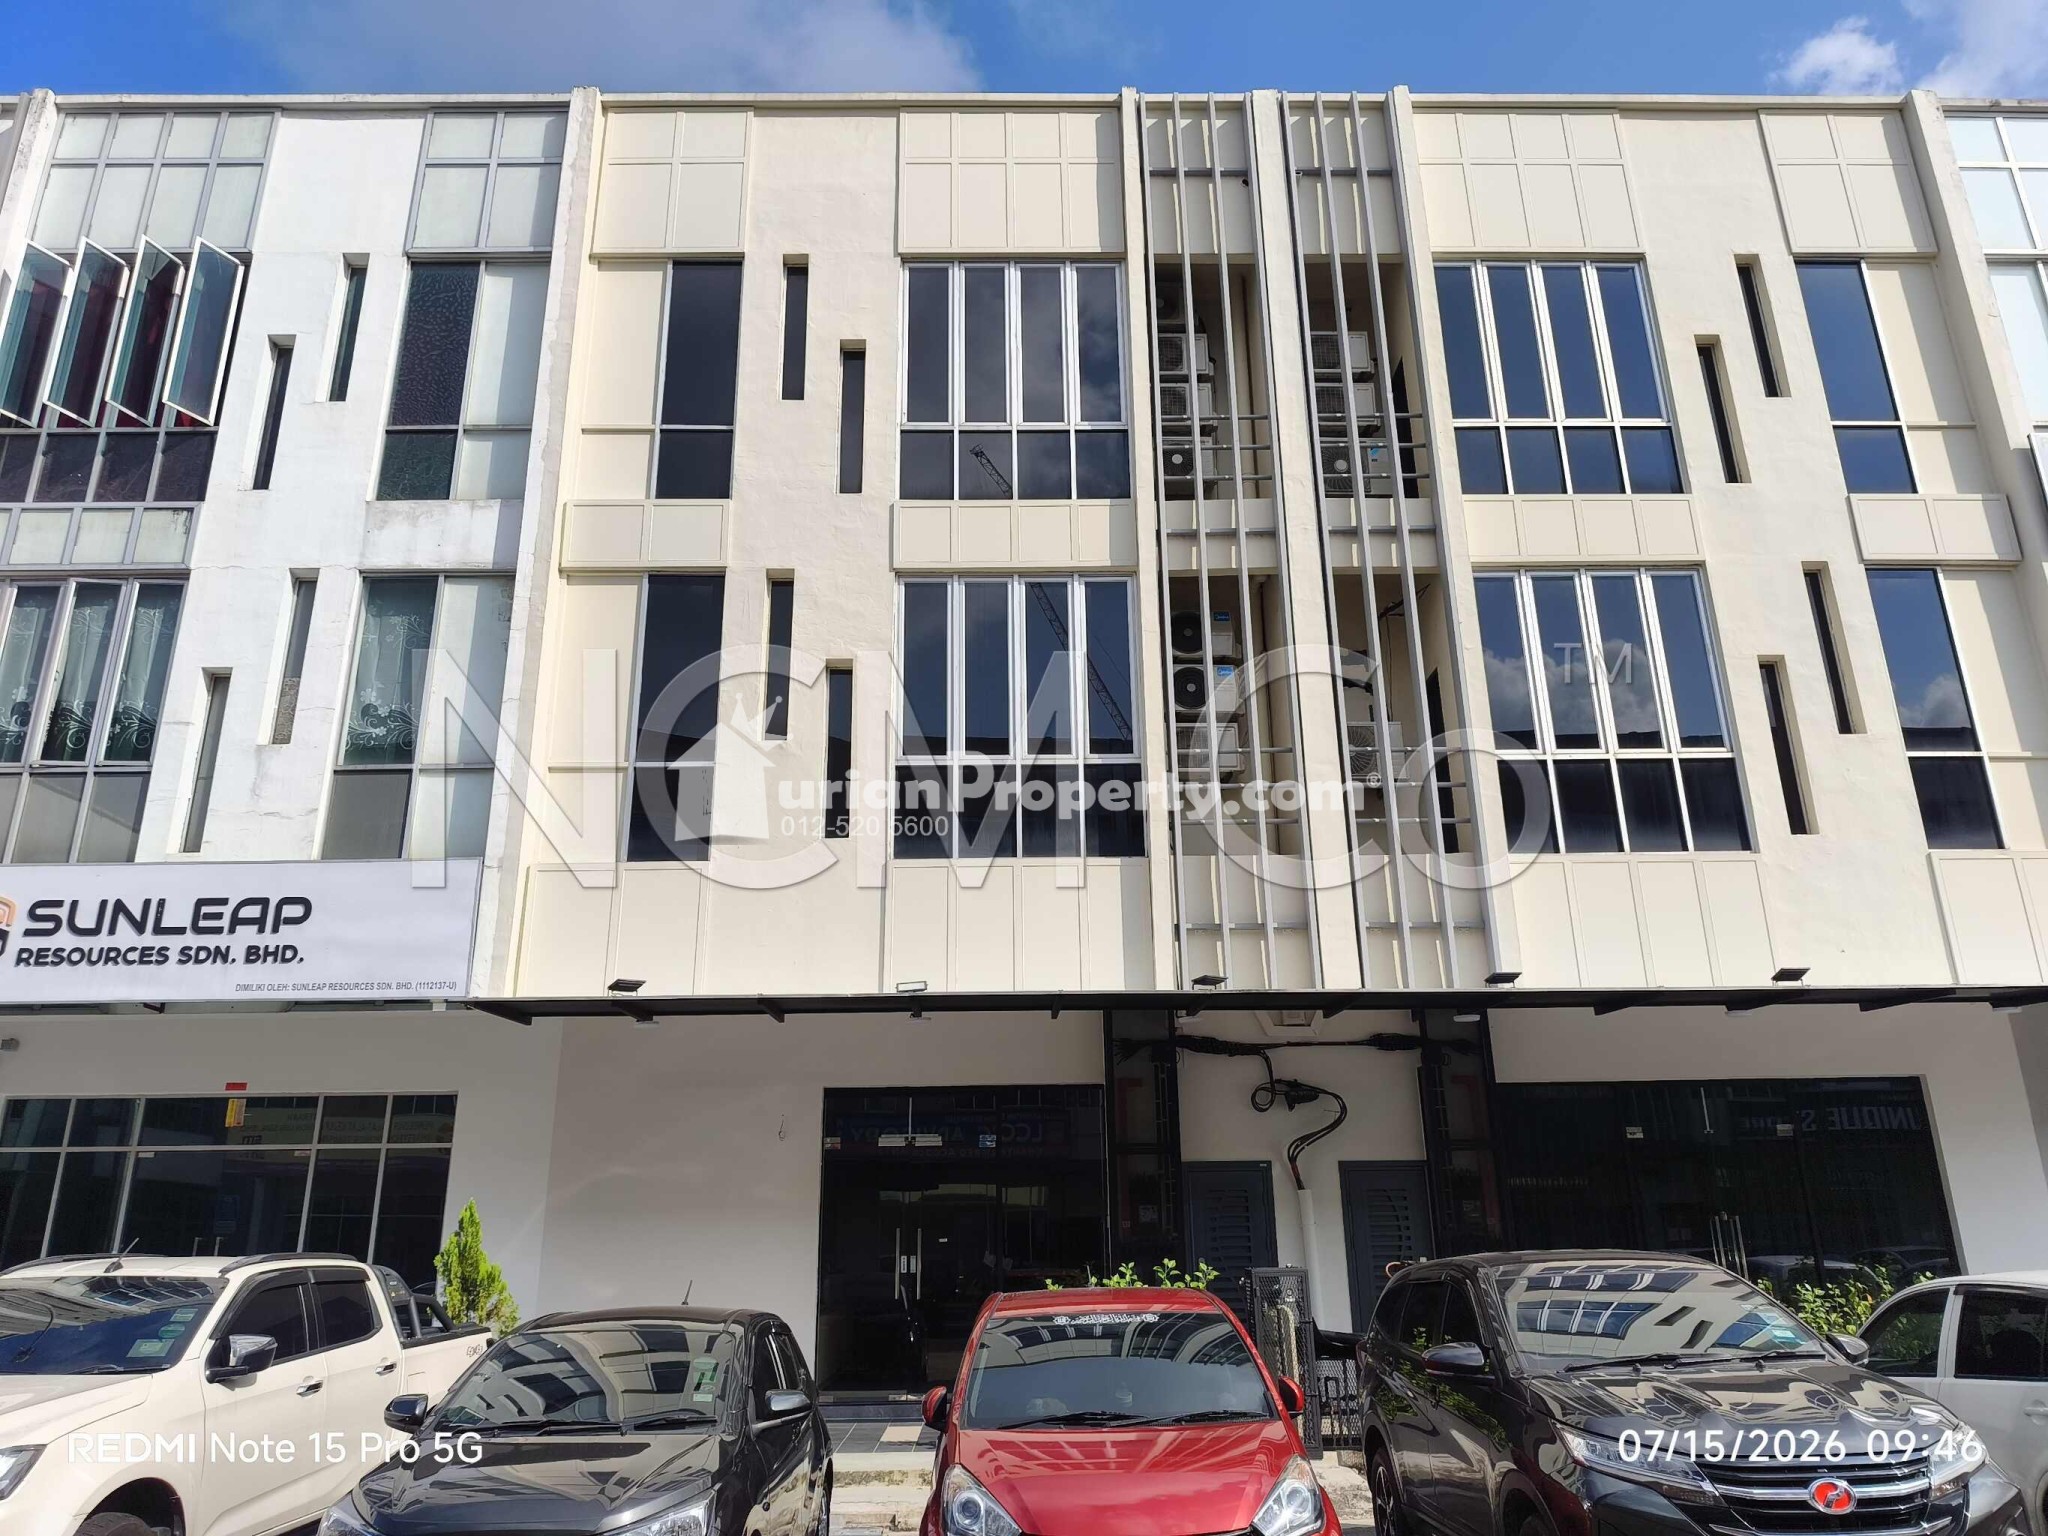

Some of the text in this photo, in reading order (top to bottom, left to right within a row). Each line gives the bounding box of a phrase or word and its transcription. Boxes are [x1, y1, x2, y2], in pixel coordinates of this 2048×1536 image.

[22, 896, 313, 937] SUNLEAP
[15, 944, 304, 968] RESOURCES SDN. BHD.
[235, 981, 457, 992] DIMILIKI OLEH: SUNLEAP RESOURCES SDN. BHD. (1112137-U)
